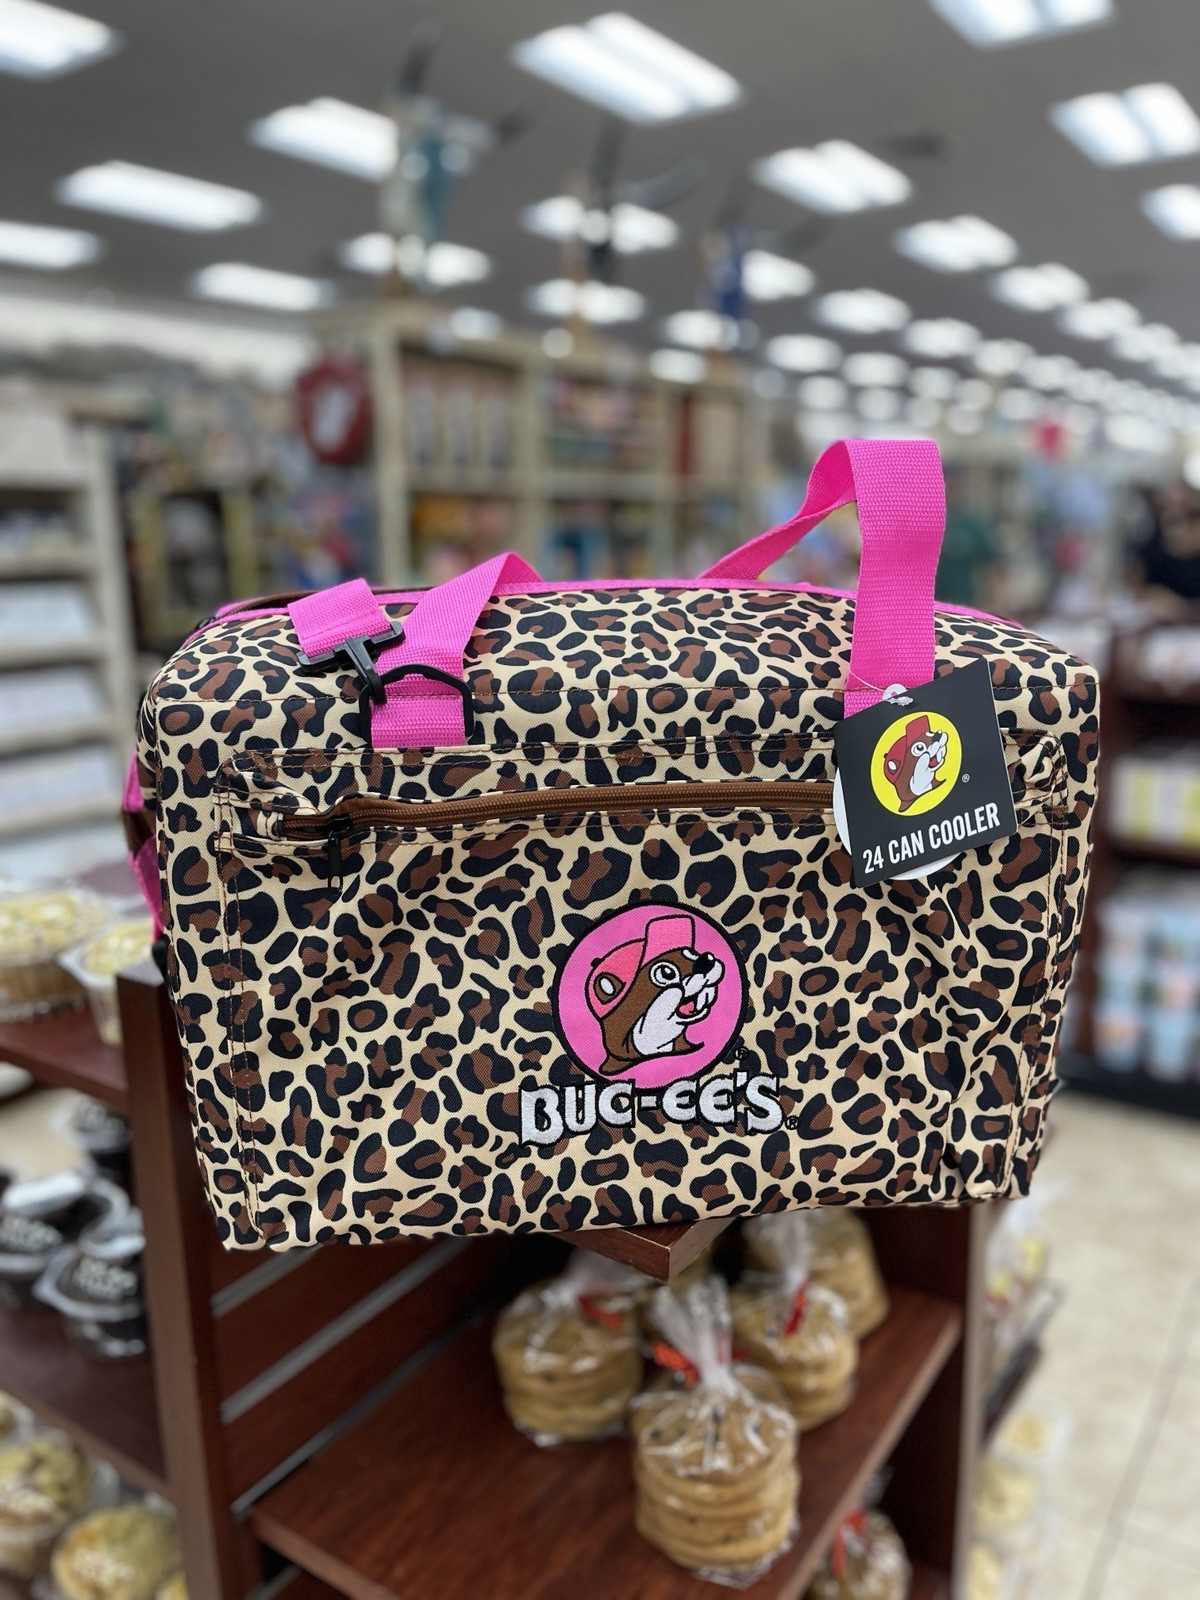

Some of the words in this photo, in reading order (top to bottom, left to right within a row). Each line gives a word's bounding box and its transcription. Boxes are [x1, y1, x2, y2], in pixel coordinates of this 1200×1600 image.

[862, 845, 884, 874] 24
[888, 830, 925, 864] CAN
[928, 802, 1000, 849] COOLER
[519, 1068, 784, 1147] BUC-EE'S
